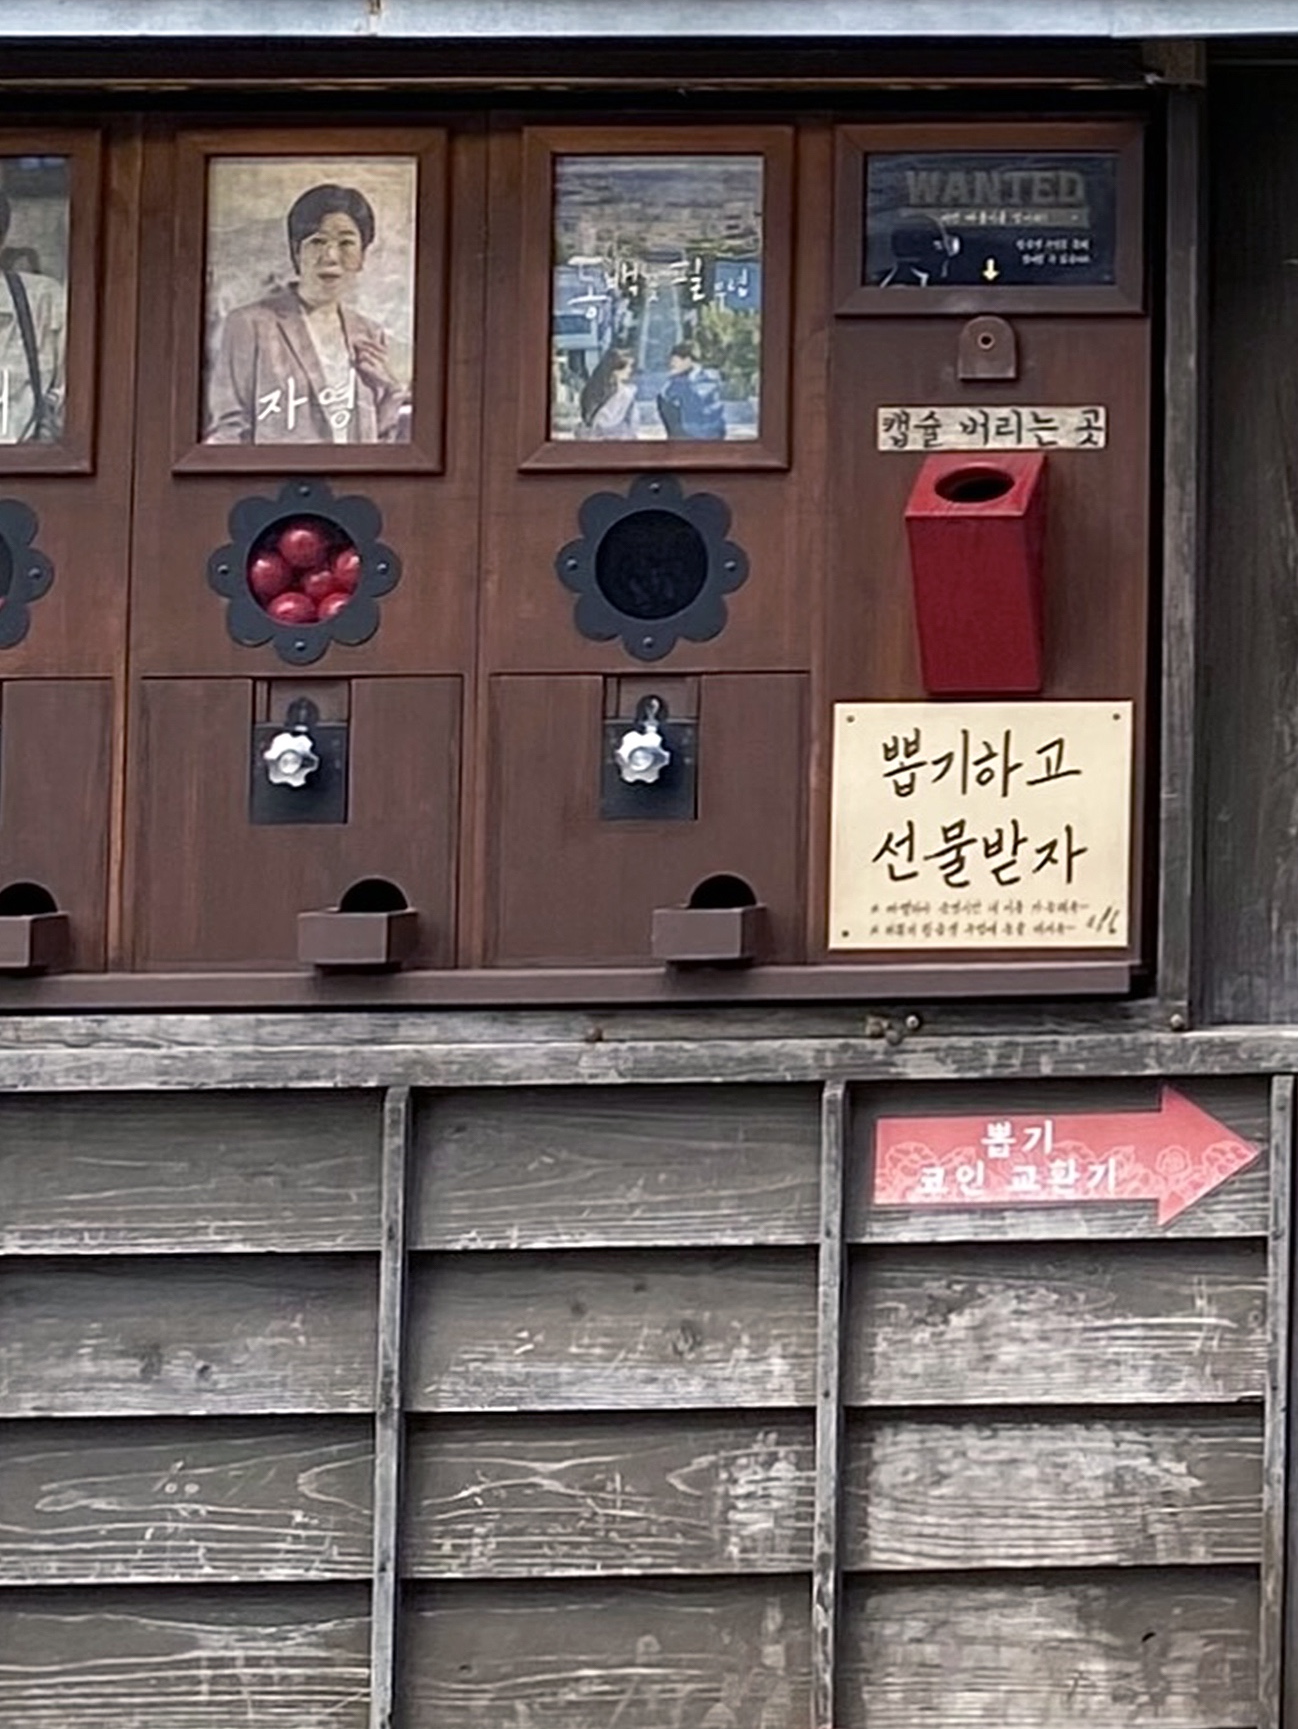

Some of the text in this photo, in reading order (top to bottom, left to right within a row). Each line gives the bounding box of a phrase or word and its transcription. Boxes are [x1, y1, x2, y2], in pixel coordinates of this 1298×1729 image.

[904, 168, 1086, 206] WANTED
[257, 367, 357, 431] 자영
[881, 408, 1105, 448] 캡슐 버리는 곳
[881, 727, 1084, 798] 뽑기하고
[871, 818, 1089, 889] 선물받자
[981, 1119, 1056, 1159] 뽑기
[915, 1157, 1120, 1197] 코인 교환기
